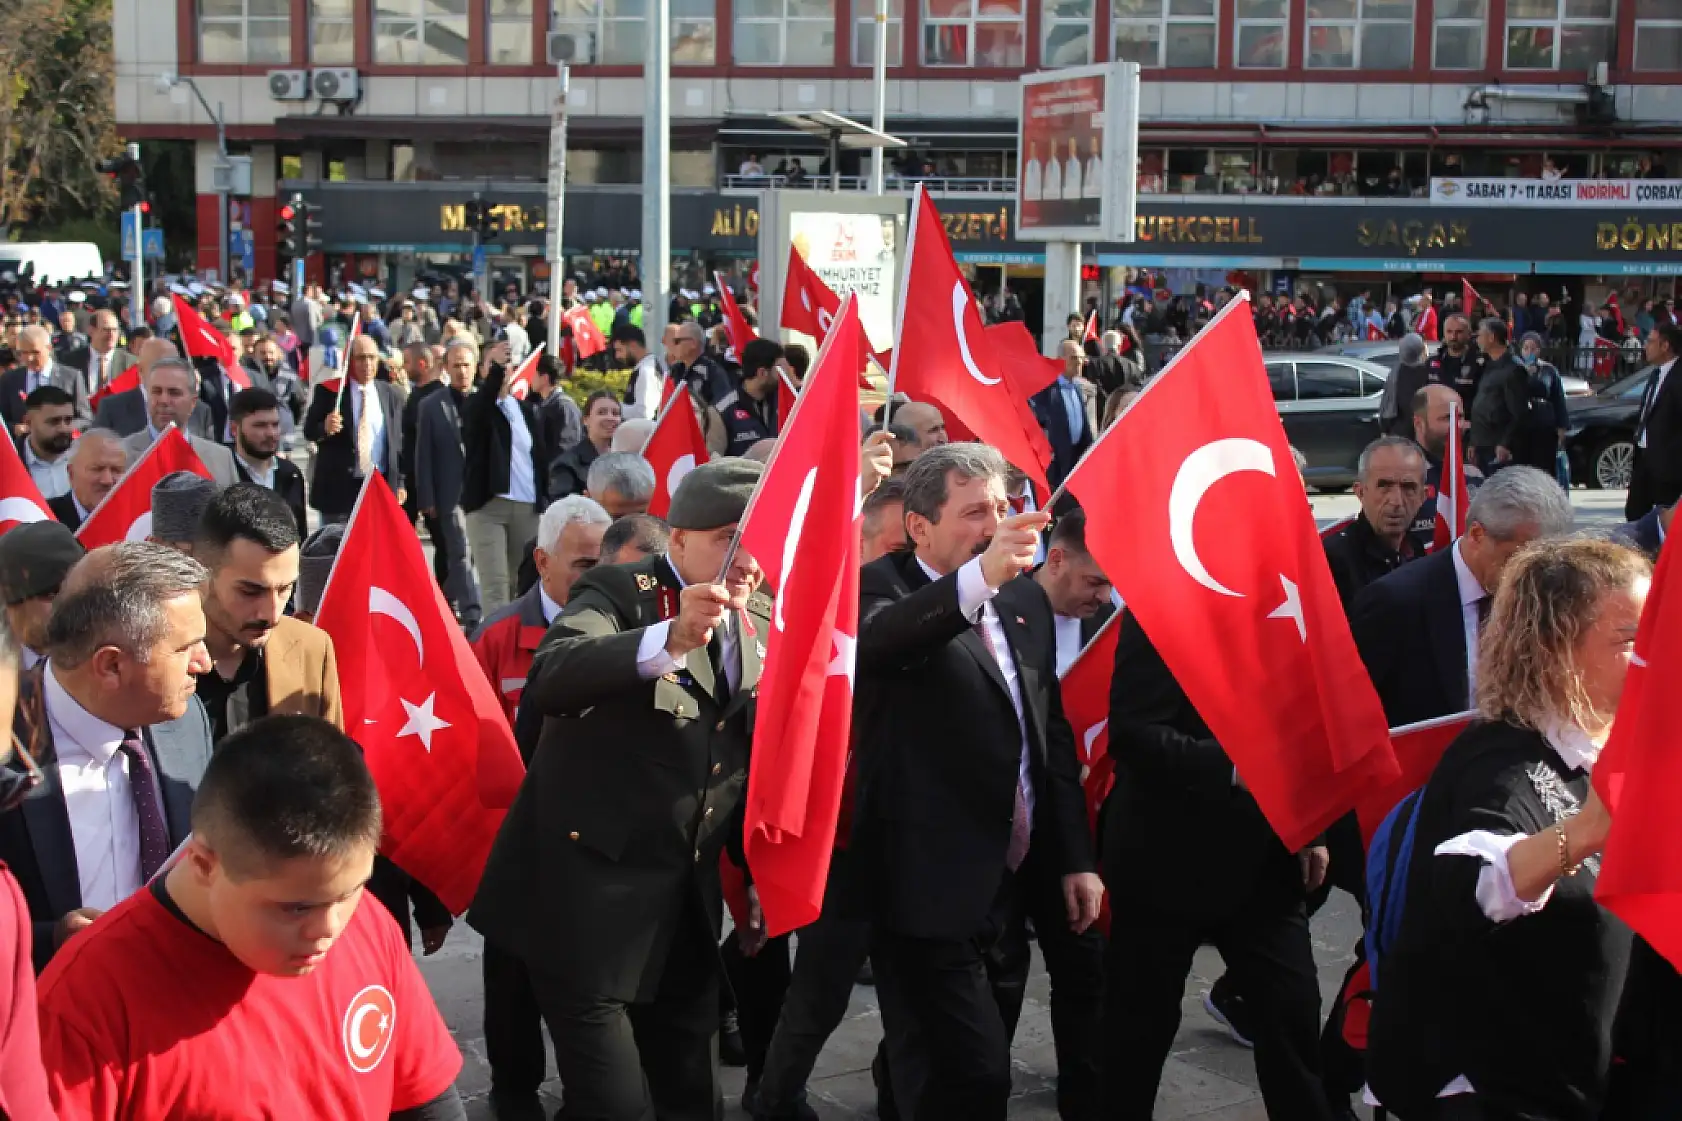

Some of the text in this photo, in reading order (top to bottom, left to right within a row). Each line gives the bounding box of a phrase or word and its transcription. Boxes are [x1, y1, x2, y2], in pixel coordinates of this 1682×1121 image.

[1466, 183, 1505, 198] SABAH
[1537, 185, 1572, 199] ARASI
[940, 206, 1008, 240] ZZET-İ
[1136, 216, 1263, 242] URKCELL
